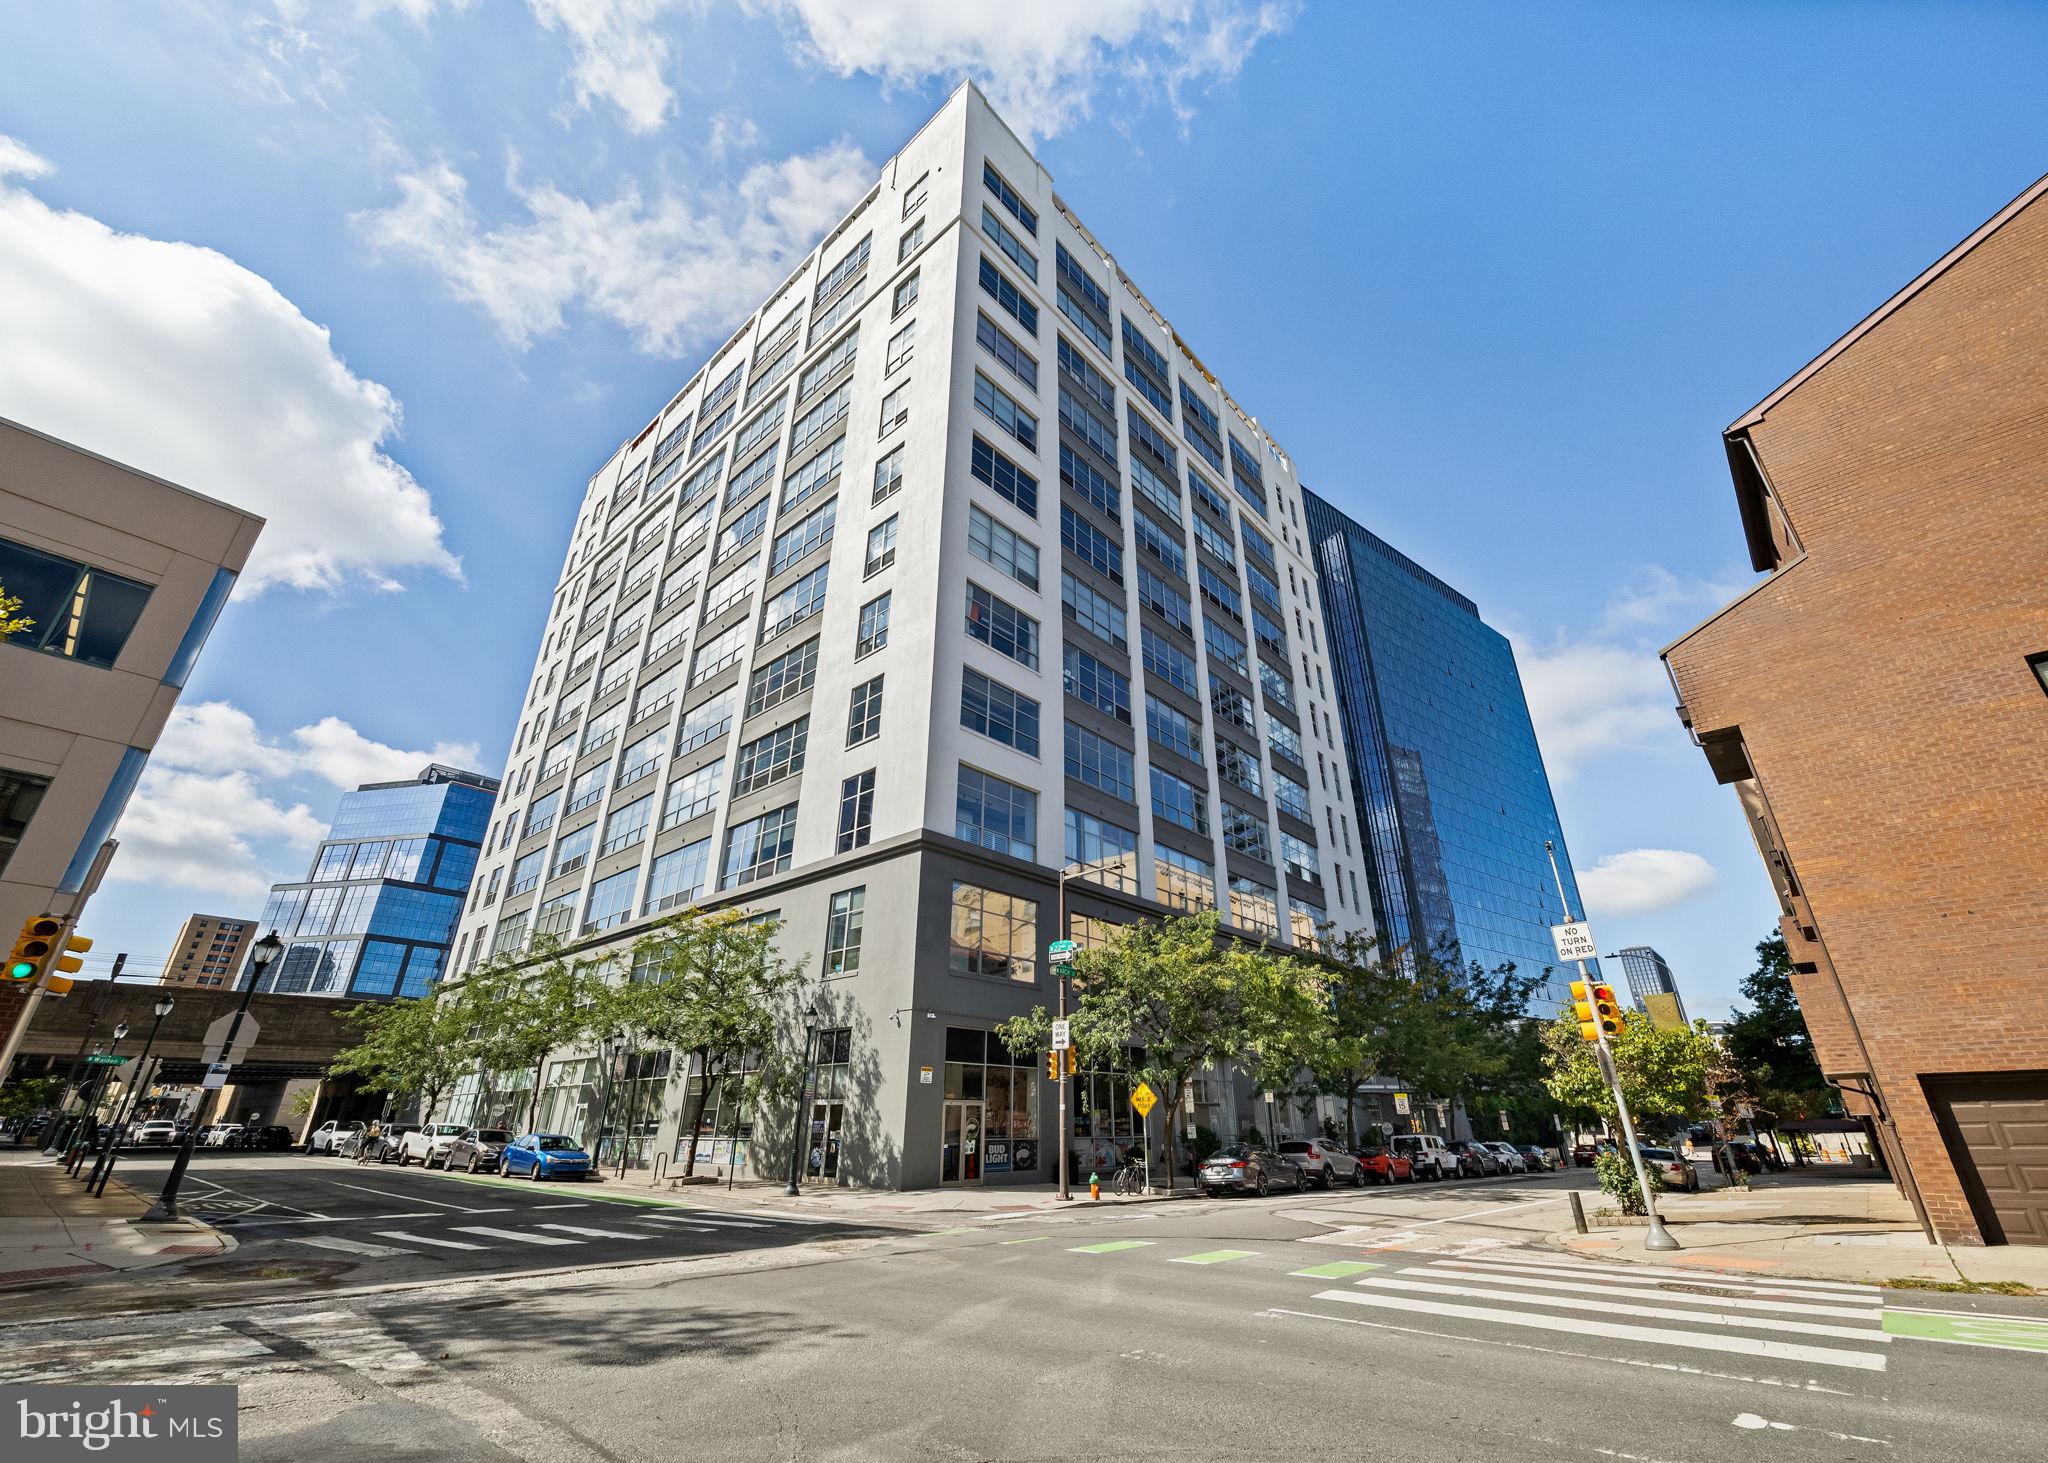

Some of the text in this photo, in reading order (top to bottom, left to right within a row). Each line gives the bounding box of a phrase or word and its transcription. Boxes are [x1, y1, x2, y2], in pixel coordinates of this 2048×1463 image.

[1564, 927, 1578, 936] NO
[1561, 936, 1587, 946] TURN
[1560, 945, 1594, 956] ON RED
[1055, 1023, 1066, 1031] ONE
[94, 1056, 118, 1065] Walden
[988, 1144, 1006, 1154] BUD
[985, 1154, 1009, 1164] LIGHT
